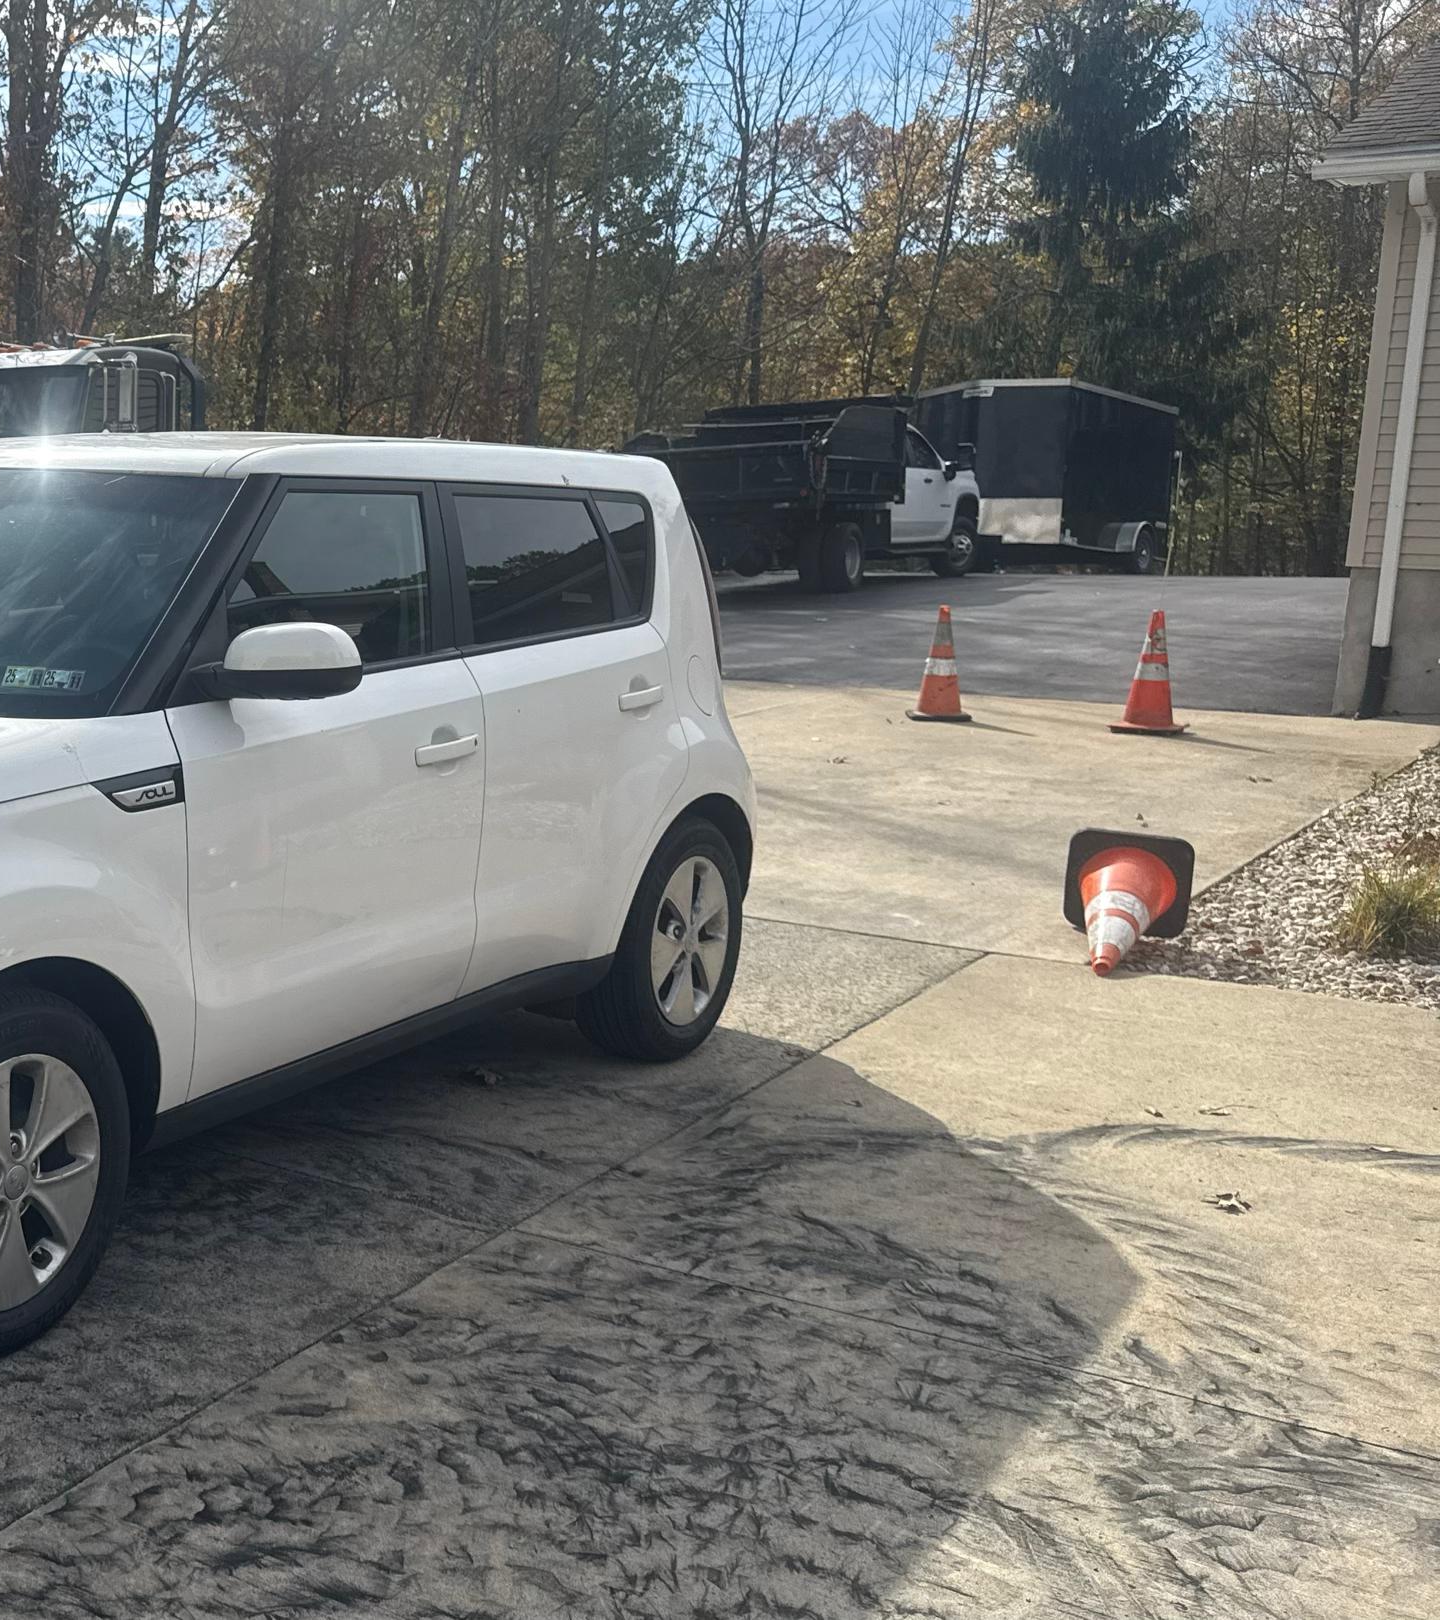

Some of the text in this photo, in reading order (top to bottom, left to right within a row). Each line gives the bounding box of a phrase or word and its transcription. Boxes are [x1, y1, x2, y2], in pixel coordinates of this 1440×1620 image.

[5, 668, 17, 683] 25
[43, 671, 56, 686] 25
[136, 786, 173, 802] SOUL
